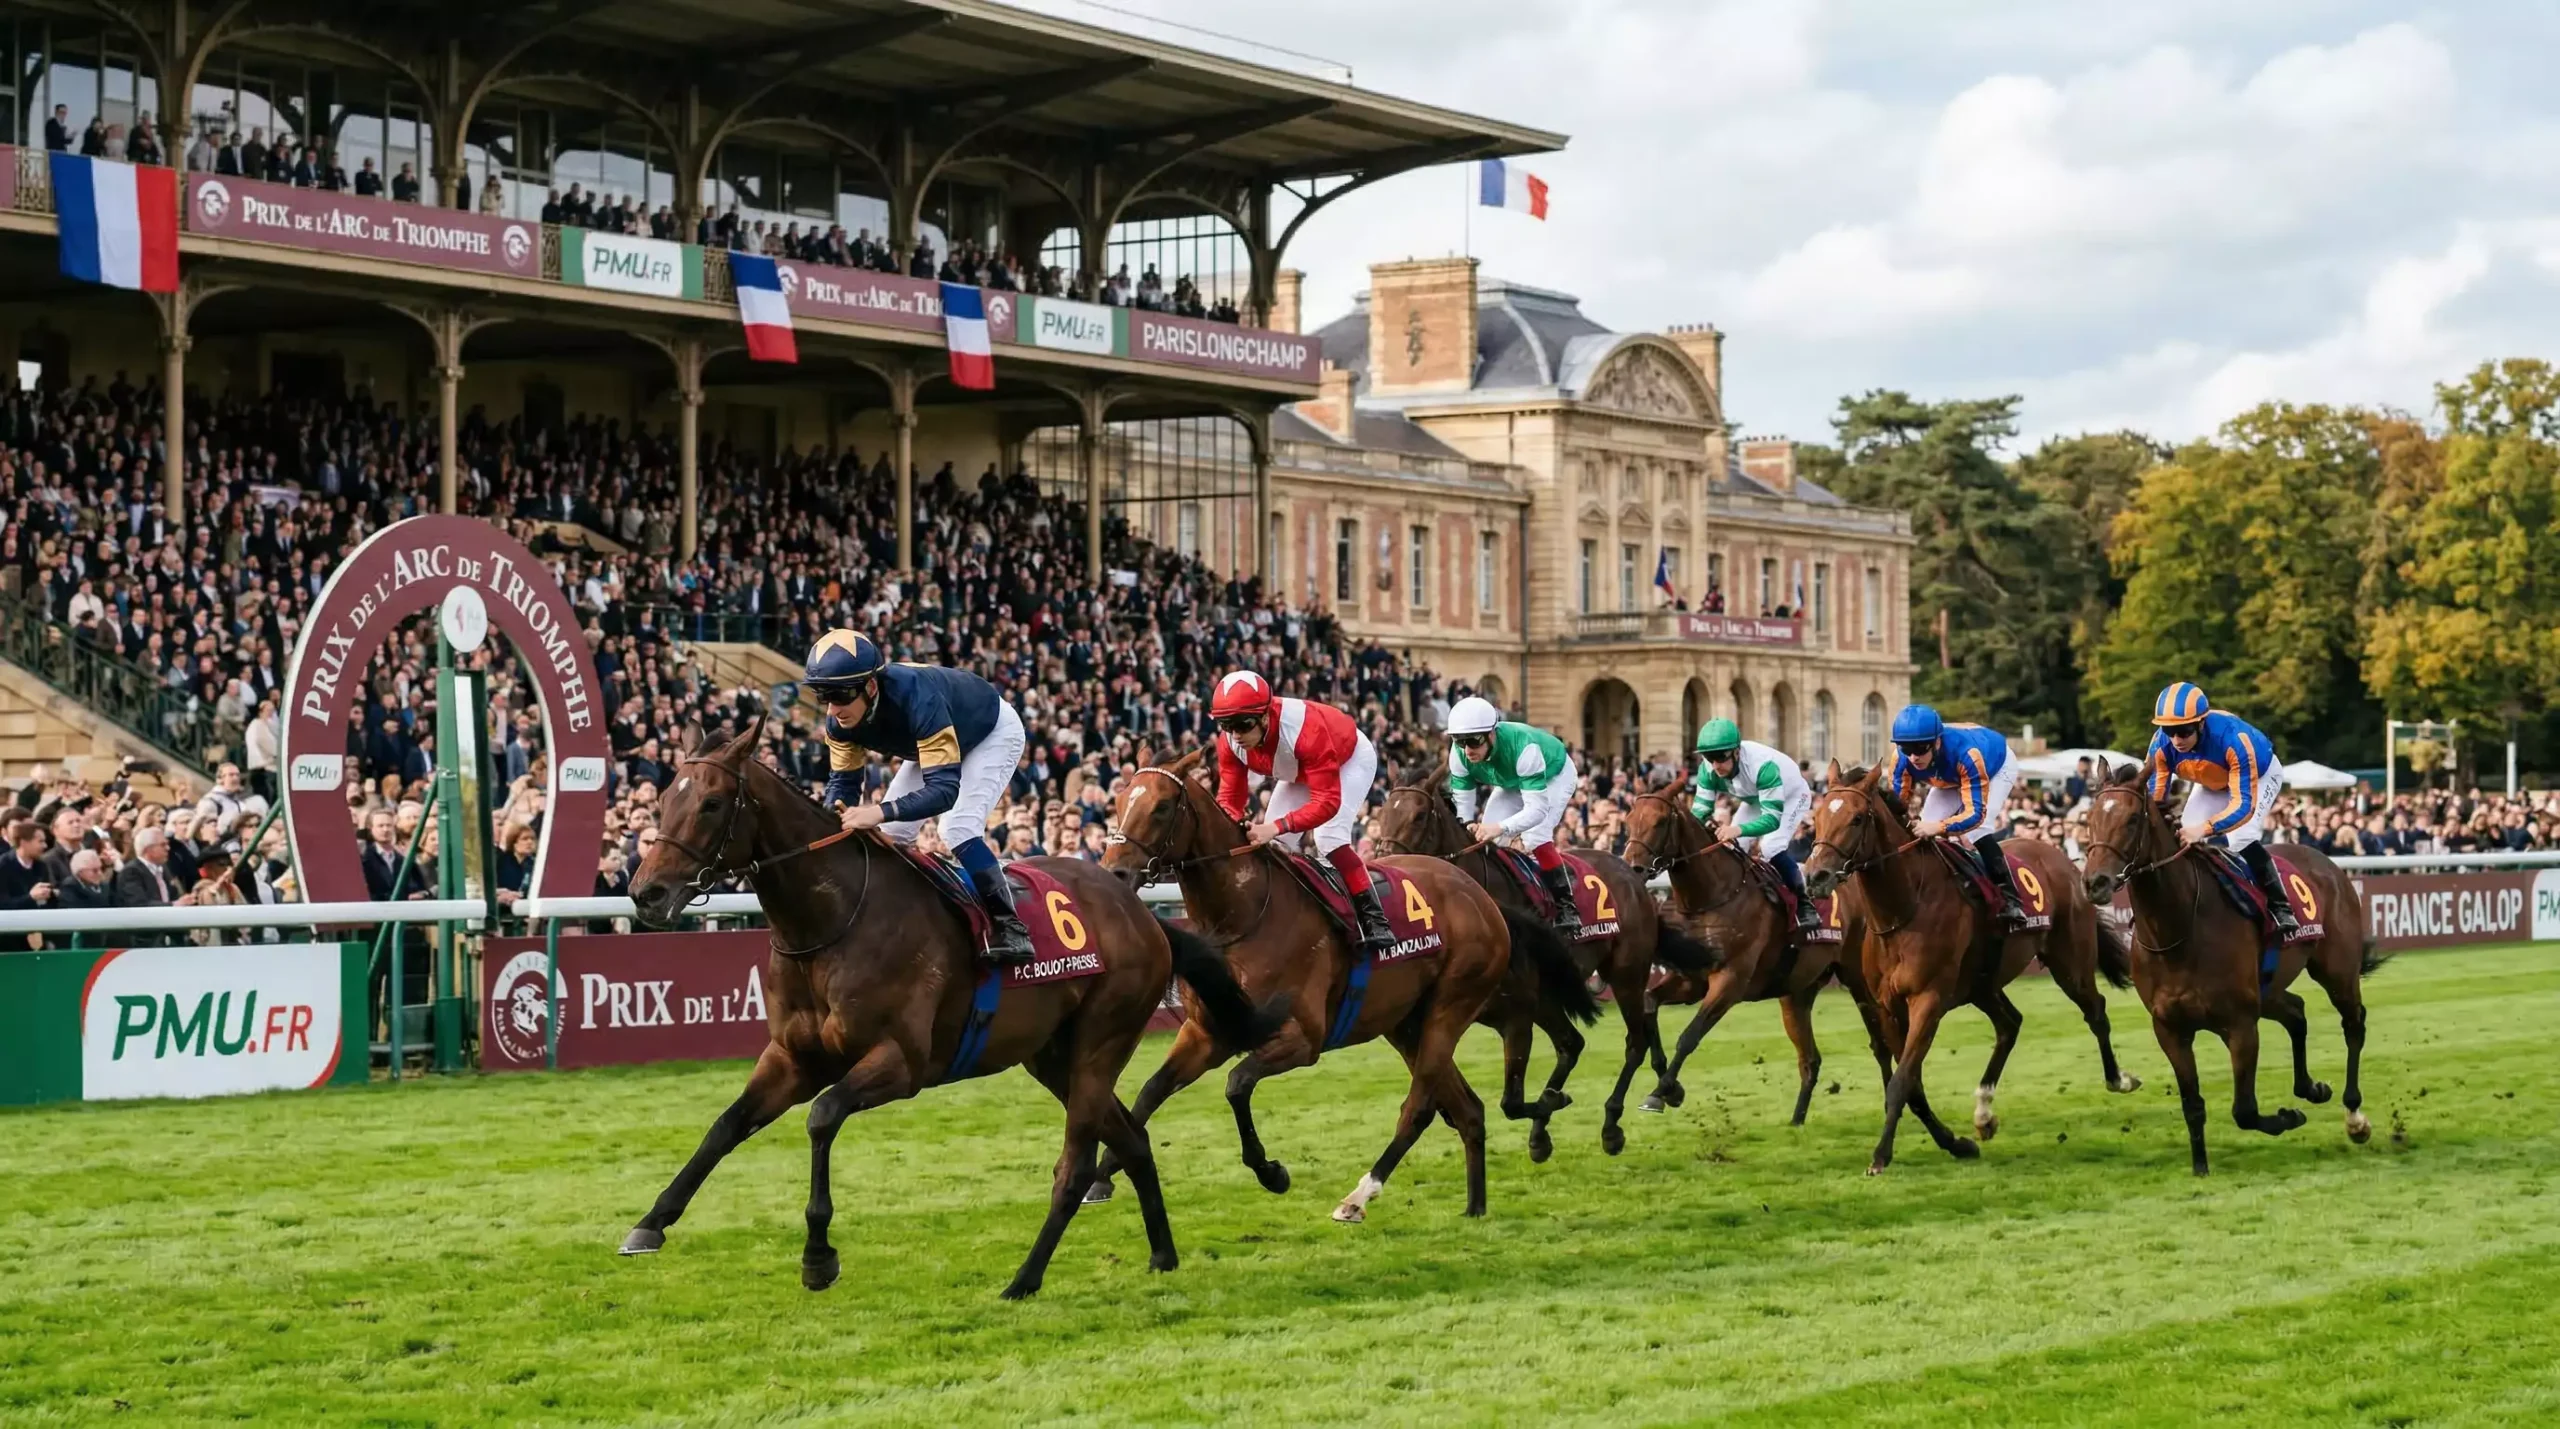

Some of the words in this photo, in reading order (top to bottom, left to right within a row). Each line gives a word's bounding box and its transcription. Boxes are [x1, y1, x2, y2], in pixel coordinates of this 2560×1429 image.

[241, 195, 291, 228] PRIX
[295, 214, 313, 232] DE
[316, 208, 370, 240] L'ARC
[373, 224, 392, 243] DE
[392, 217, 491, 256] TRIOMPHE
[593, 246, 672, 282] PMU.FR
[805, 277, 842, 304] PRIX
[859, 285, 898, 312] L'ARC
[1041, 310, 1105, 342] PMU.FR
[1143, 322, 1308, 370] PARISLONGCHAMP
[301, 623, 356, 727] PRIX
[349, 593, 377, 631] DE
[375, 545, 451, 603] L'ARC
[456, 555, 483, 582] DE
[489, 550, 592, 733] TRIOMPHE
[1401, 879, 1435, 930] 4
[1583, 874, 1616, 920] 2
[2017, 867, 2044, 912] 9
[2289, 874, 2317, 920] 9
[2371, 891, 2455, 938] FRANCE
[2458, 888, 2523, 933] GALOP
[1045, 890, 1087, 951] 6
[112, 989, 313, 1061] PMU.FR
[580, 973, 675, 1029] PRIX
[683, 996, 715, 1025] DE
